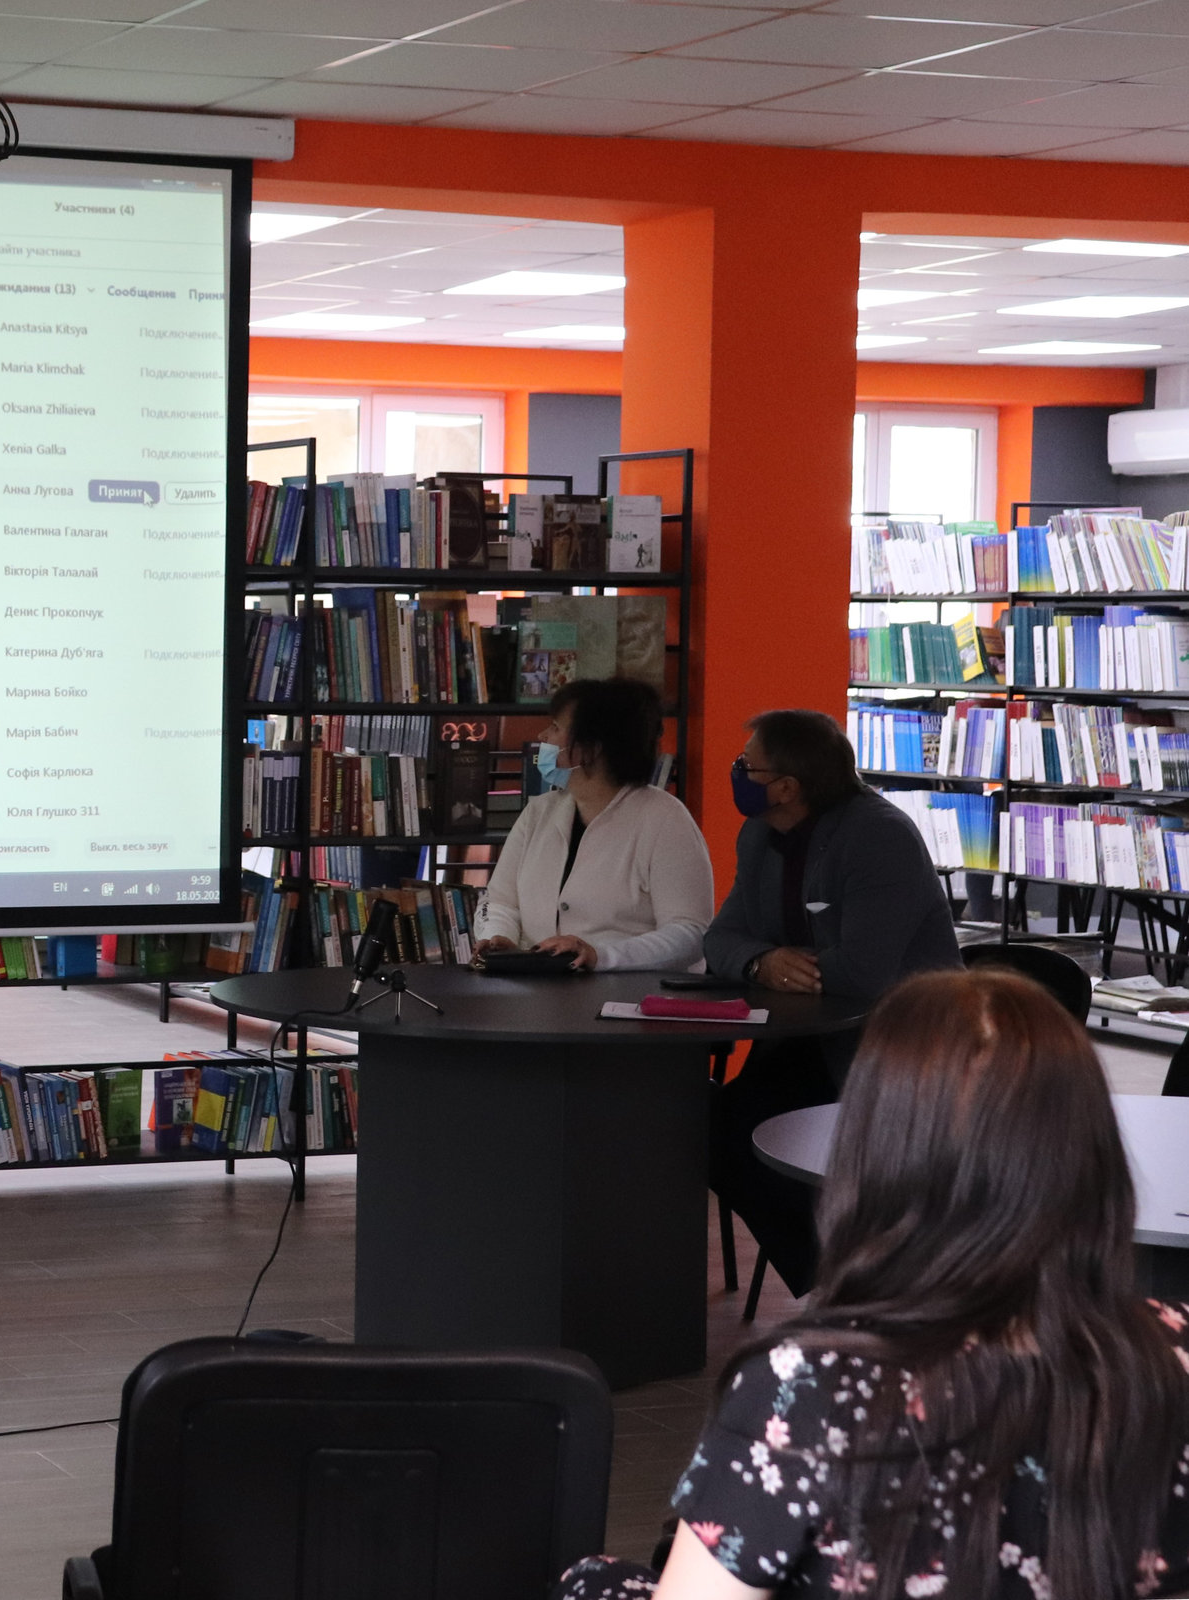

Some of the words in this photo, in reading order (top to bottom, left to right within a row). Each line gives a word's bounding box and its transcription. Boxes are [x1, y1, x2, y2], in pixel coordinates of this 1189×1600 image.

[54, 201, 116, 216] Участники
[119, 205, 135, 216] (4)
[54, 283, 76, 296] (13)
[0, 322, 52, 335] Anastasia
[55, 324, 88, 338] Kitsya
[1, 362, 34, 374] Maria
[36, 363, 86, 375] Klimchak
[2, 403, 42, 416] Oksana
[2, 443, 33, 455] Xenia
[37, 444, 67, 456] Galka
[3, 485, 31, 496] Анна
[34, 485, 74, 498] Лугова
[174, 488, 216, 500] Удалить
[3, 525, 61, 537] Валентина
[65, 527, 108, 538] Галаган
[4, 566, 49, 579] Вікторія
[52, 566, 99, 578] Талалай
[5, 607, 39, 618] Денис
[42, 607, 103, 619] Прокопчук
[5, 647, 58, 660] Катерина
[6, 687, 51, 700] Марина
[55, 686, 88, 698] Бойко
[6, 727, 41, 740] Марія
[44, 727, 79, 738] Бабич
[7, 766, 40, 780] Софія
[43, 767, 93, 779] Карлюка
[7, 807, 33, 817] Юля
[36, 807, 77, 820] Глушко
[80, 807, 100, 816] 311
[90, 842, 119, 854] Выкл.
[122, 842, 144, 851] весь
[147, 842, 168, 853] звук
[191, 875, 211, 885] 9:59
[53, 883, 68, 892] EN
